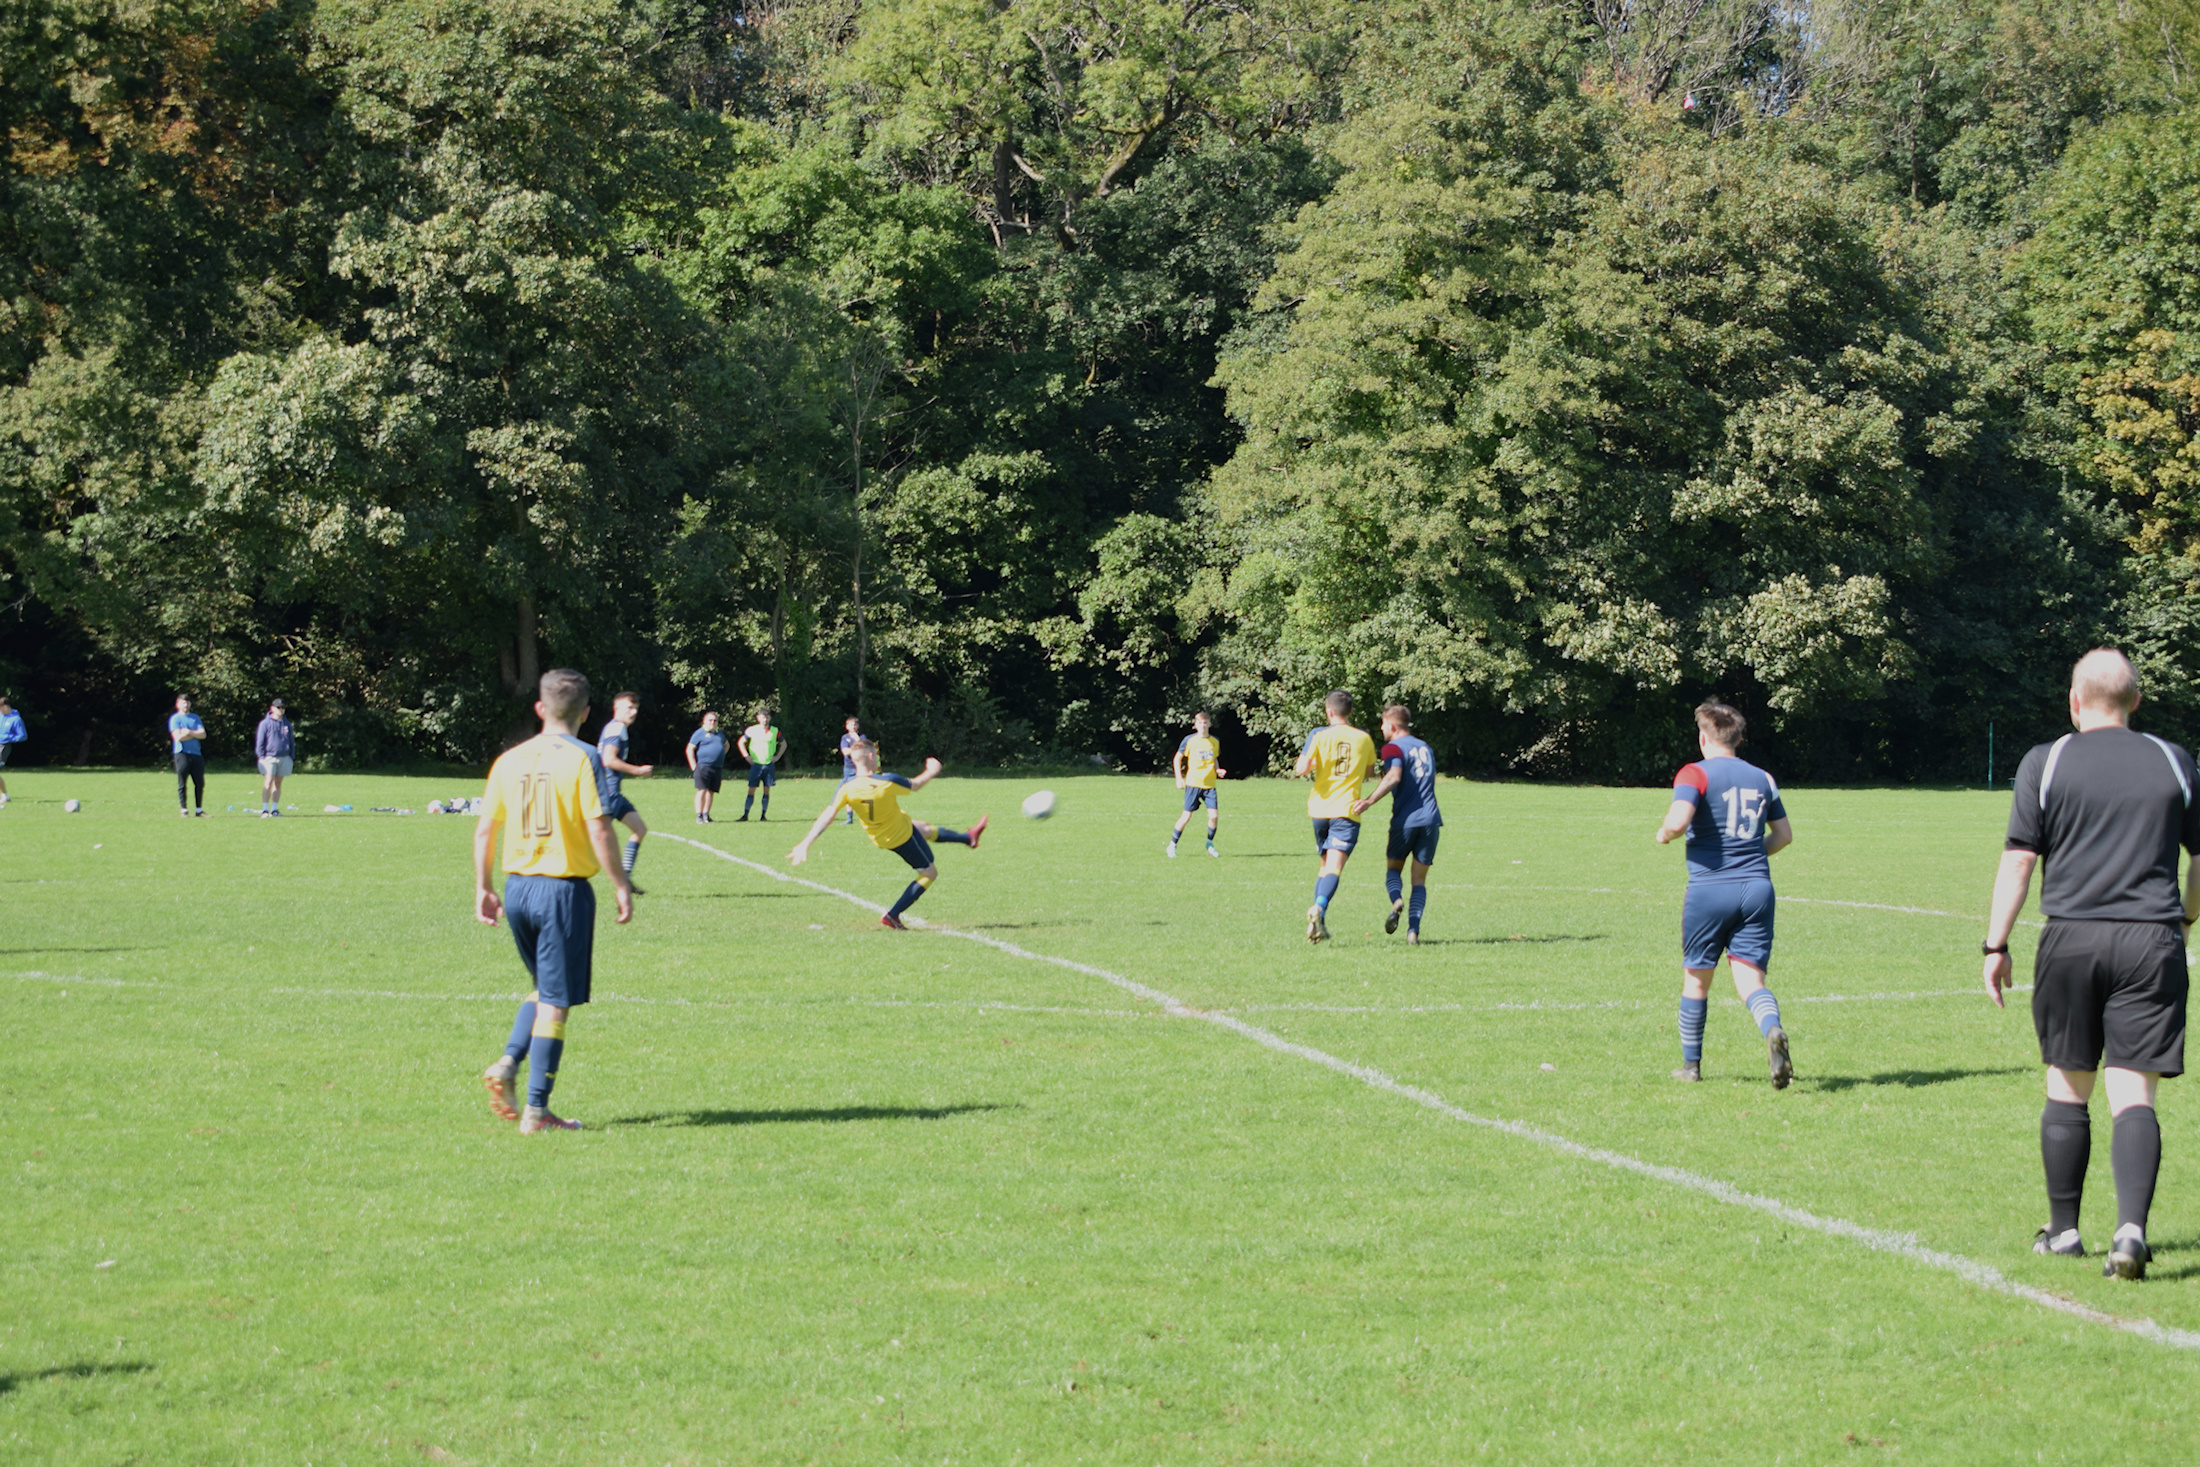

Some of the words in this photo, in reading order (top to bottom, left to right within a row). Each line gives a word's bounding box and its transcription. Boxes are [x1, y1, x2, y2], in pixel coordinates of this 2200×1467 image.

[1335, 742, 1351, 777] 8
[520, 772, 553, 839] 10
[860, 799, 874, 821] 7
[1722, 785, 1760, 839] 15
